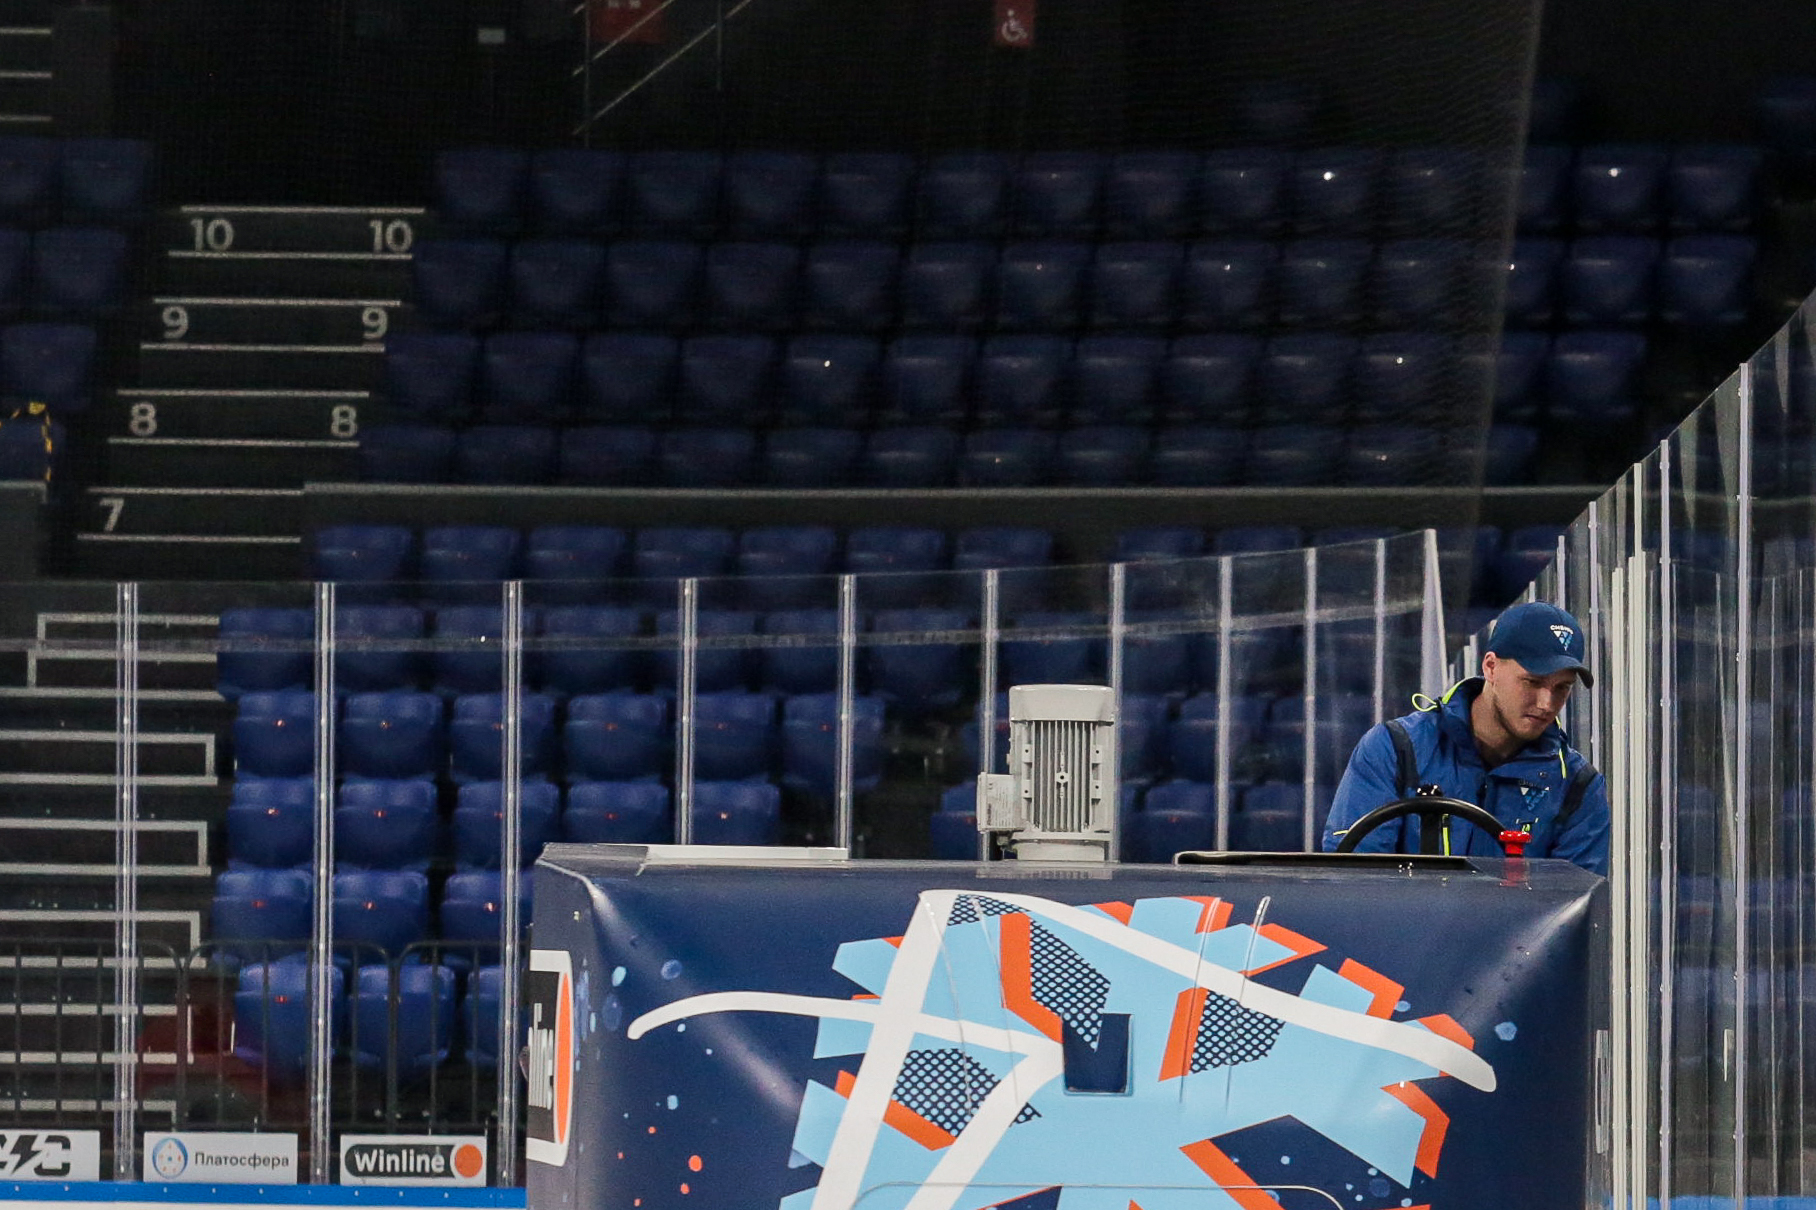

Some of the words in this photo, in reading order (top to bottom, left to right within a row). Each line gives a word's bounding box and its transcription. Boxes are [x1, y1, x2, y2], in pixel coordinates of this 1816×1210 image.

[190, 219, 235, 252] 10
[369, 220, 413, 253] 10
[161, 306, 189, 339] 9
[361, 307, 388, 340] 9
[129, 402, 157, 436] 8
[330, 405, 357, 438] 8
[99, 498, 124, 532] 7
[194, 1152, 290, 1170] Платосфера
[354, 1149, 445, 1173] Winline
